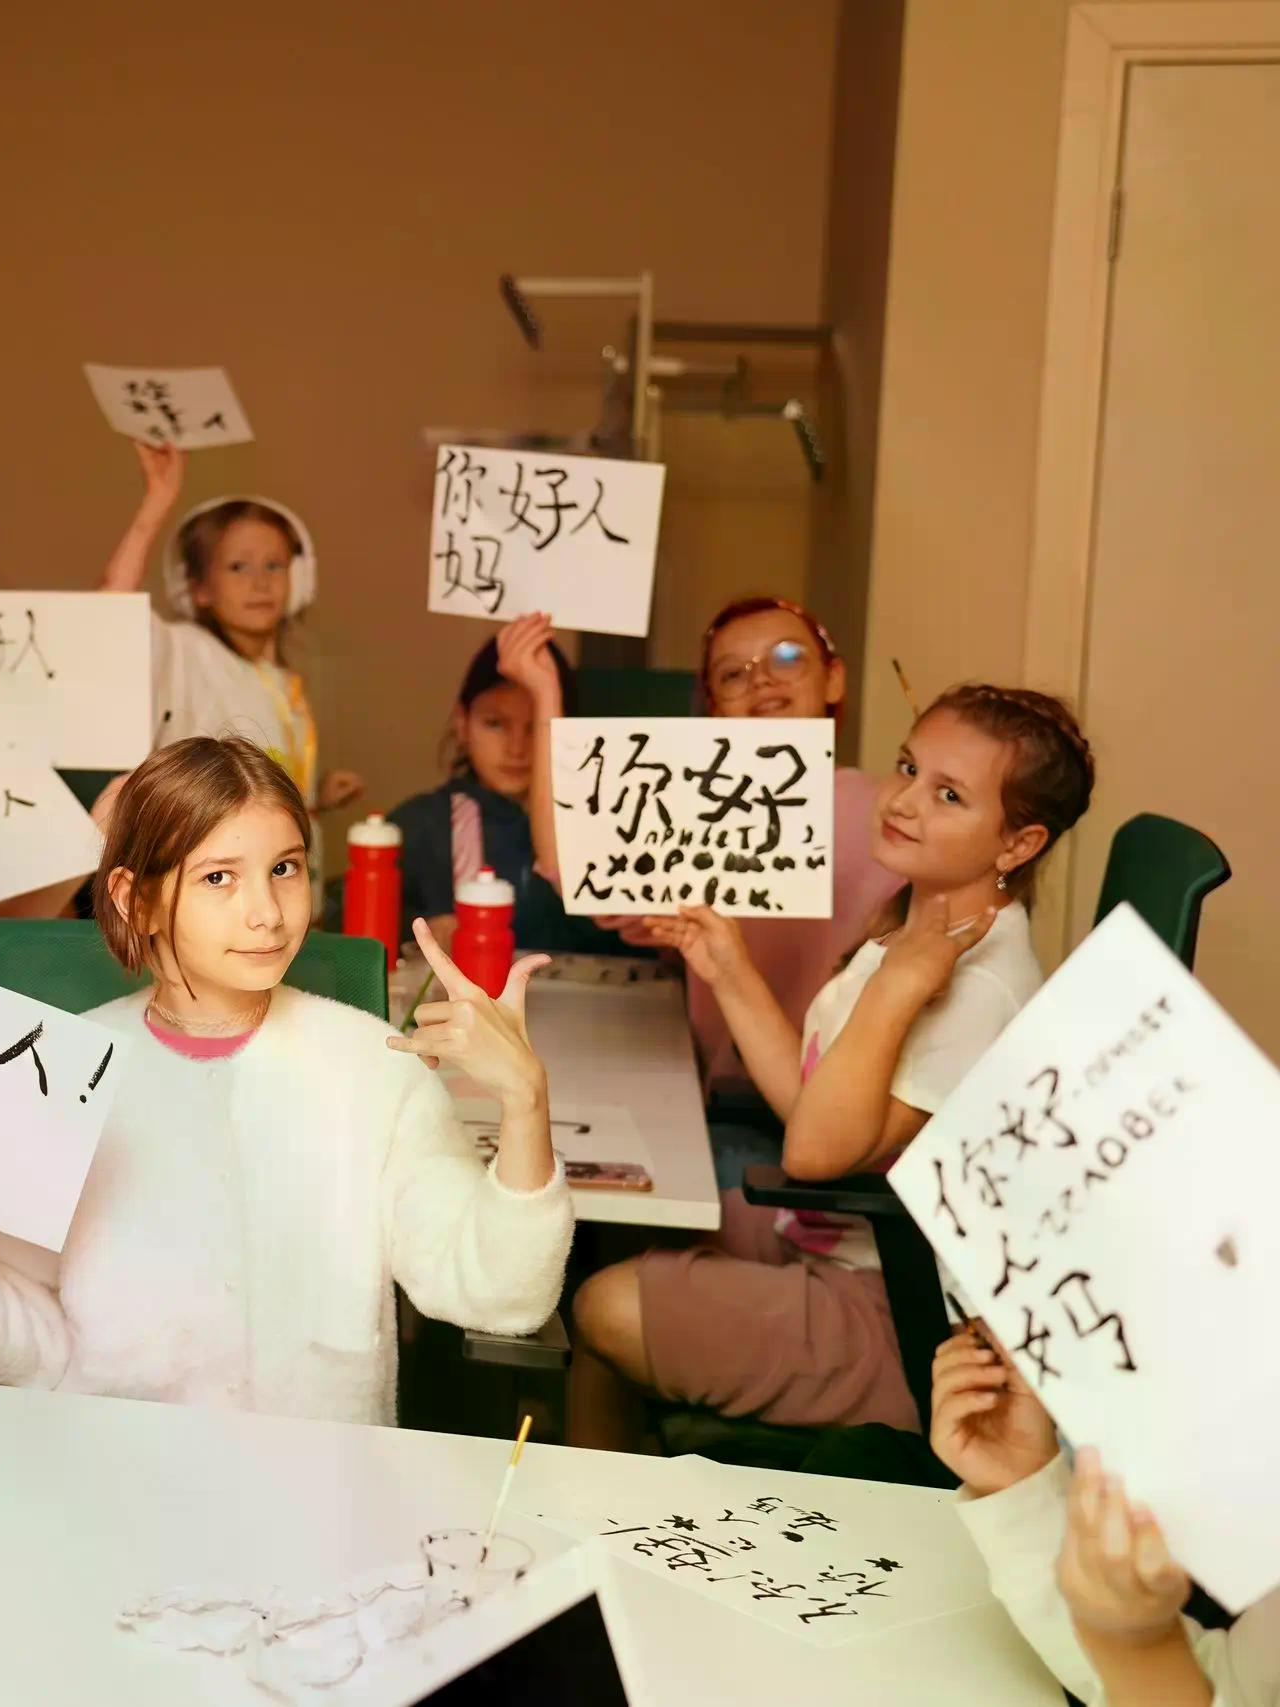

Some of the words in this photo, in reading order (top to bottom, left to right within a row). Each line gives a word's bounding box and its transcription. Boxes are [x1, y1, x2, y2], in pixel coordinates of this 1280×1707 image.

[435, 450, 629, 551] 你好人
[434, 531, 505, 614] 妈
[577, 733, 808, 855] 你好
